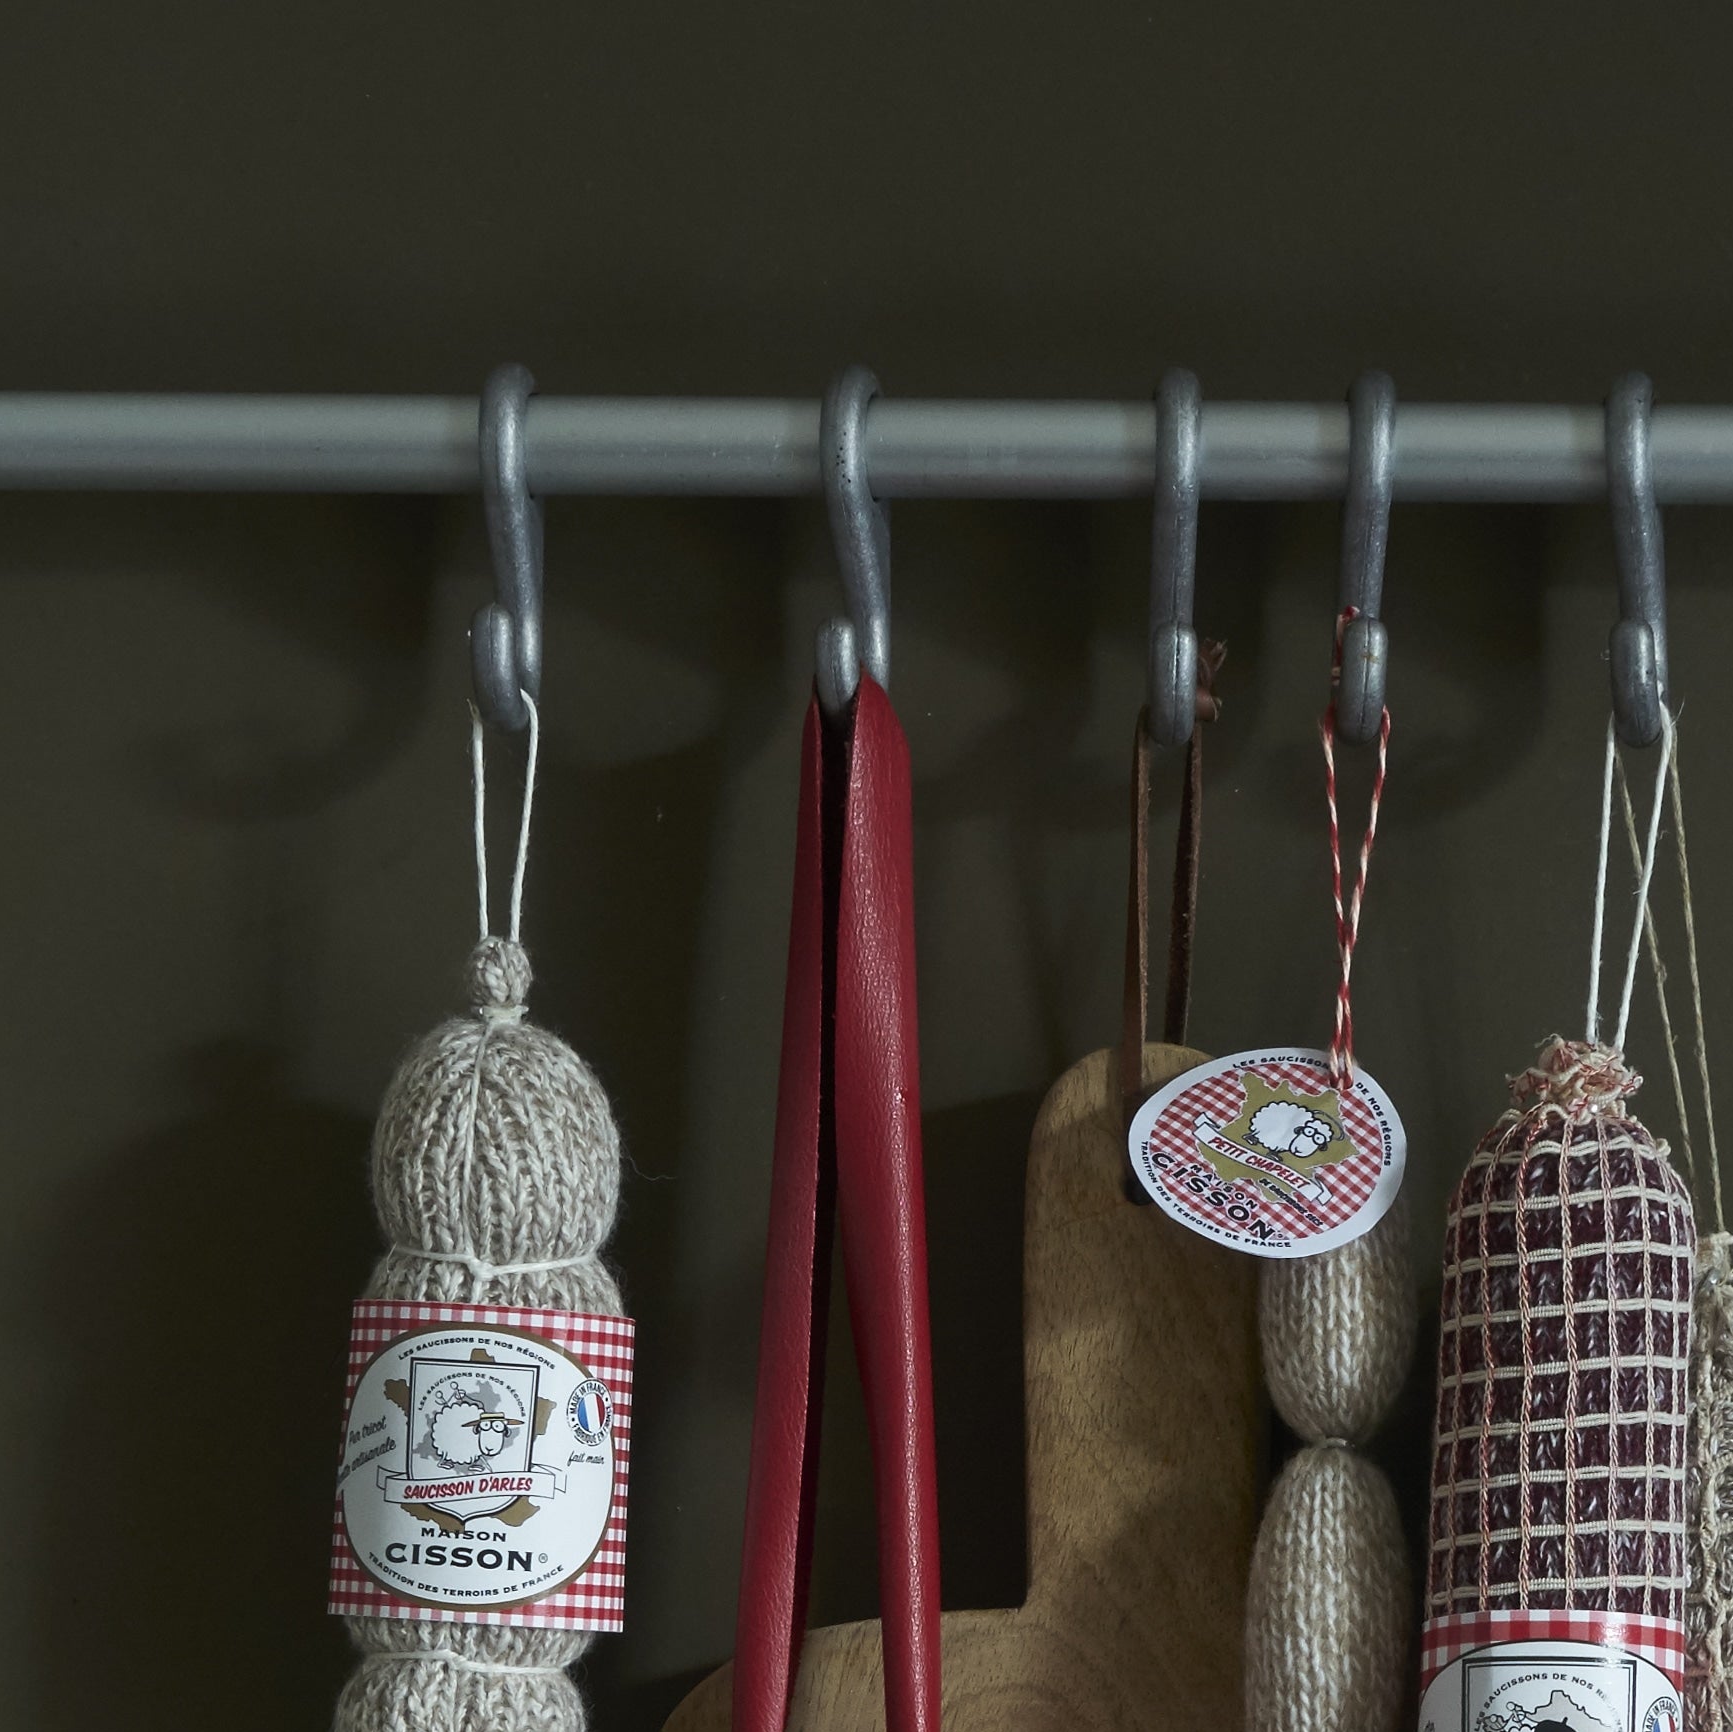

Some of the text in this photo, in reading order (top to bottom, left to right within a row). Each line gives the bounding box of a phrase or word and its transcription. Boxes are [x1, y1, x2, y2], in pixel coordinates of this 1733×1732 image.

[1233, 1056, 1392, 1166] LES SAUCISSON DE NOS RÉGIONS
[1207, 1136, 1311, 1189] PETIT CHAPELET
[1141, 1141, 1292, 1248] TRADITION DES TERROIRS DE FRANCE
[1190, 1164, 1258, 1209] MAISON
[398, 1348, 414, 1360] LES
[416, 1337, 474, 1352] SAUCISSONS
[494, 1340, 513, 1349] NOS
[516, 1346, 556, 1370] RÉGIONS
[418, 1395, 427, 1411] LES
[427, 1372, 473, 1391] SAUCISSONS
[489, 1376, 504, 1385] NOS
[569, 1392, 580, 1414] MADE
[403, 1477, 533, 1500] SAUCISSON D'ARLES
[421, 1527, 507, 1542] MAISON
[369, 1552, 415, 1587] TRADITION
[418, 1582, 439, 1593] DES
[442, 1588, 499, 1597] TERROIRS
[522, 1565, 564, 1589] FRANCE
[1474, 1711, 1486, 1732] LES
[1484, 1673, 1548, 1709] SAUCISSONS
[1571, 1676, 1594, 1690] NOS
